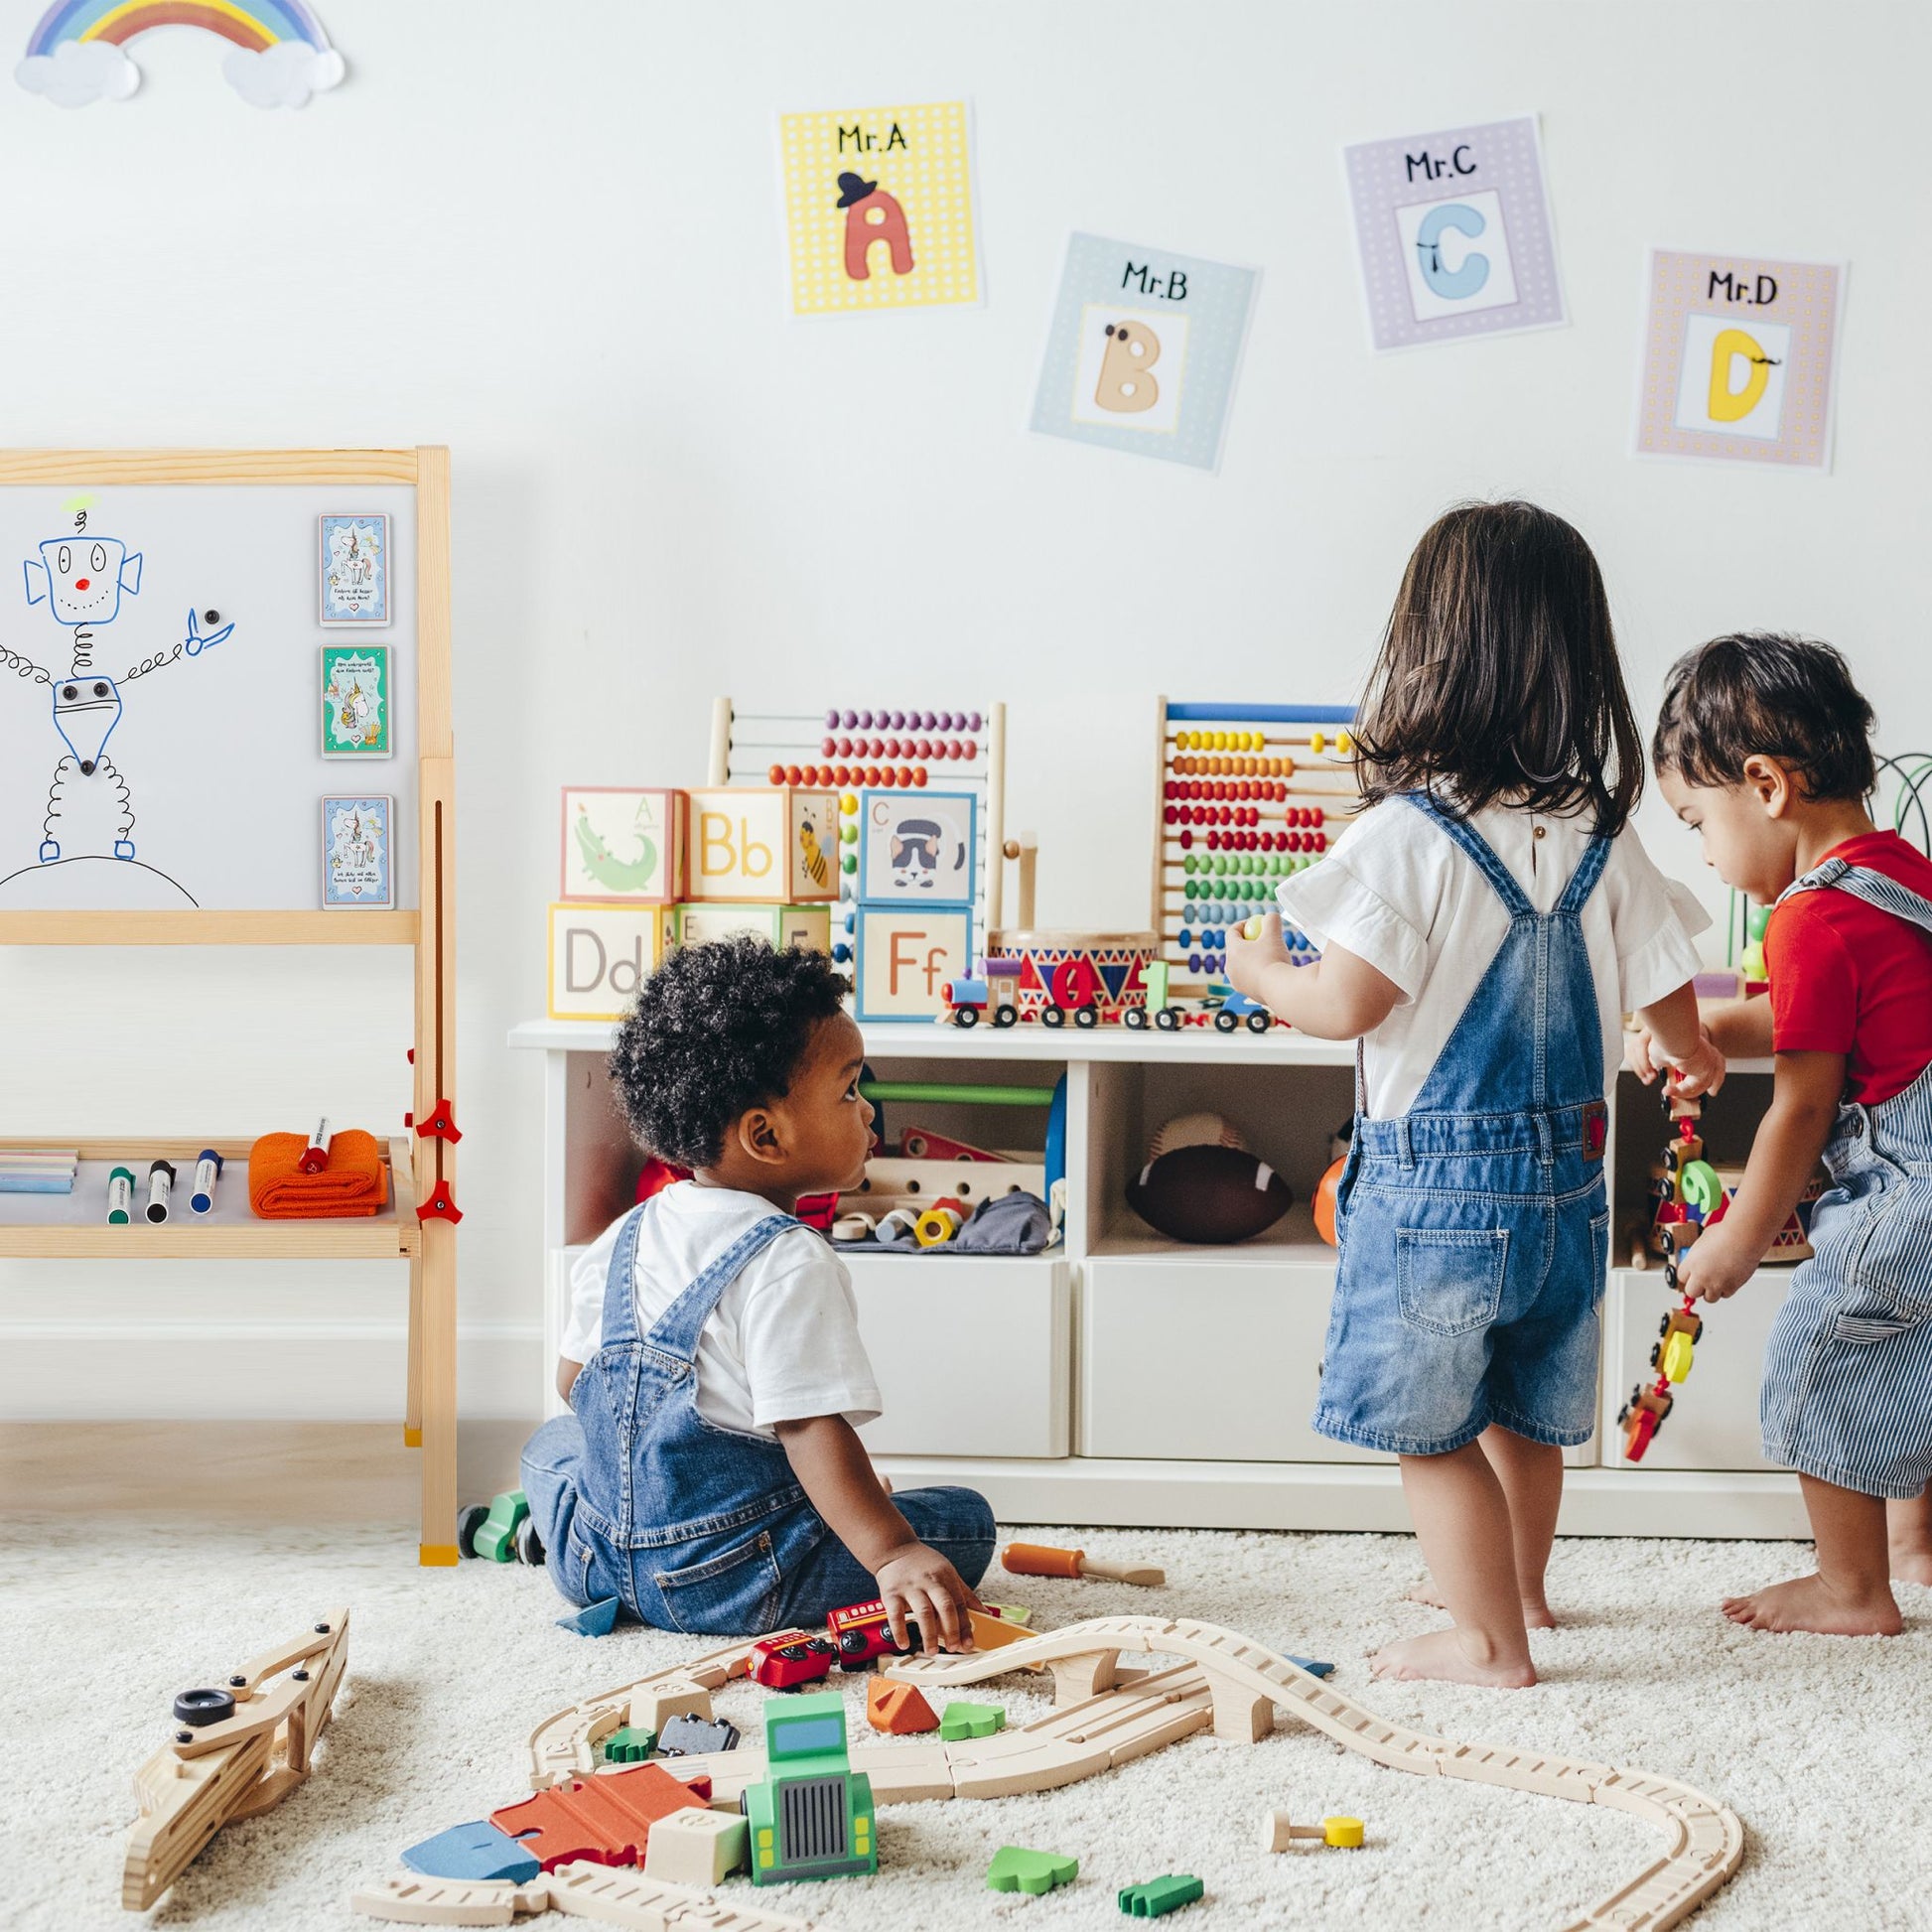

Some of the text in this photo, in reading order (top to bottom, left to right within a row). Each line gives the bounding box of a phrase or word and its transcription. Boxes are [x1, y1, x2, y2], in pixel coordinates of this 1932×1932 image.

[838, 123, 907, 153] Mr.A
[1405, 145, 1476, 182] Mr.C
[844, 189, 914, 281] A
[1417, 204, 1490, 300] C
[1122, 261, 1188, 300] Mr.B
[1707, 271, 1778, 305] Mr.D
[1095, 320, 1161, 413] B
[1708, 329, 1769, 422] D
[635, 795, 652, 821] A
[872, 801, 890, 826] C
[701, 812, 772, 878] Bb
[566, 928, 641, 995] Dd
[891, 931, 948, 996] Ff
